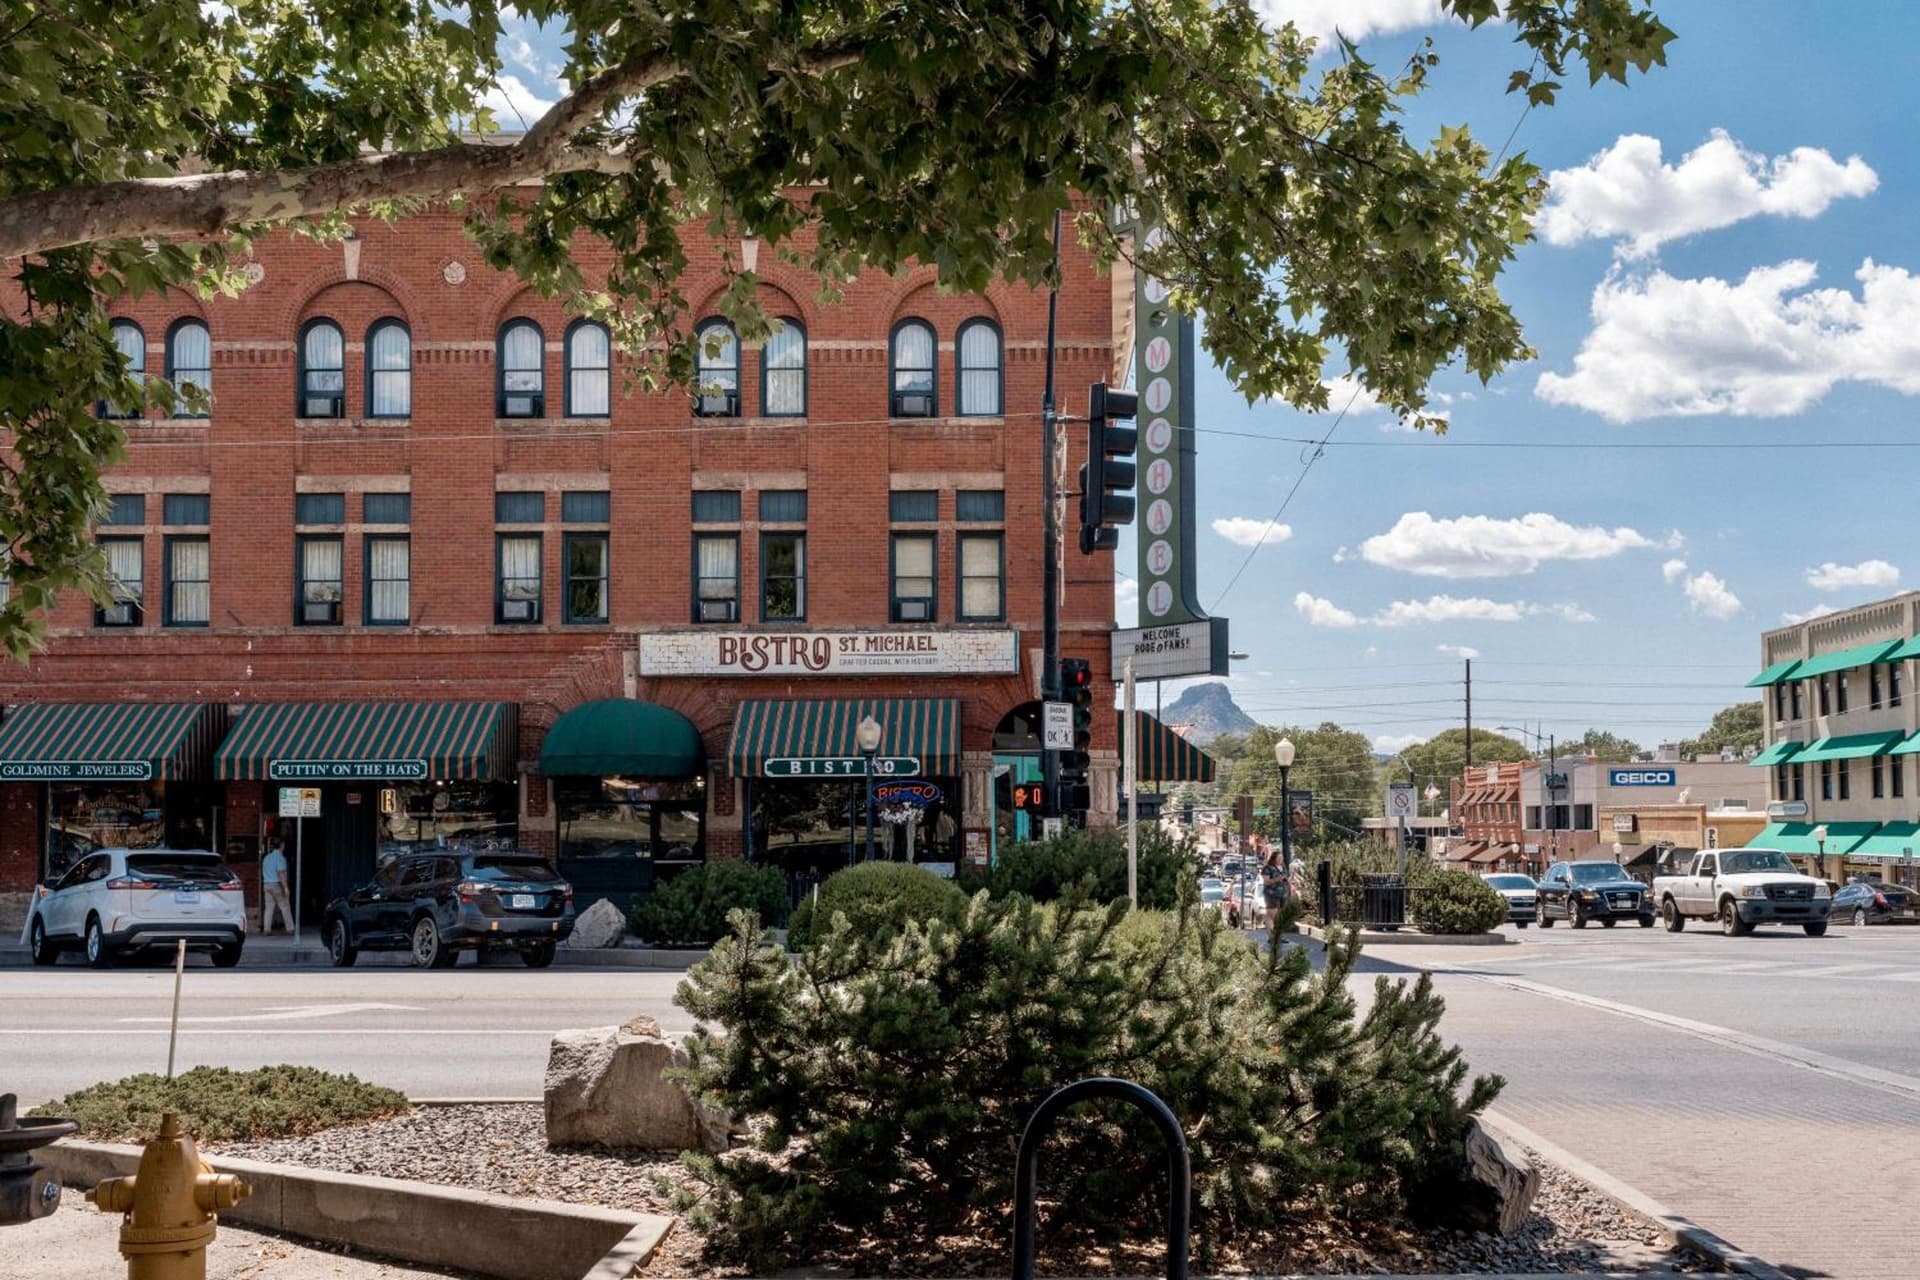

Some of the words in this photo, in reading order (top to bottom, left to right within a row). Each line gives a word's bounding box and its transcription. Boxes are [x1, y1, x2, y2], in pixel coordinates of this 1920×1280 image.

[1149, 340, 1168, 613] MICHAEL
[1142, 627, 1180, 641] WELCOME
[839, 636, 860, 652] ST.
[865, 635, 938, 652] MICHAEL
[1164, 637, 1190, 651] FANS!
[718, 635, 831, 672] BISTRO
[1047, 730, 1058, 743] OK
[2, 765, 71, 776] GOLDMINE
[77, 765, 144, 776] JEWELERS
[277, 764, 329, 776] PUTTIN'
[332, 764, 351, 776] ON
[354, 764, 382, 776] THE
[386, 764, 420, 776] HATS
[1615, 772, 1671, 784] GEICO
[878, 785, 936, 799] BISRO
[1033, 788, 1041, 805] 0
